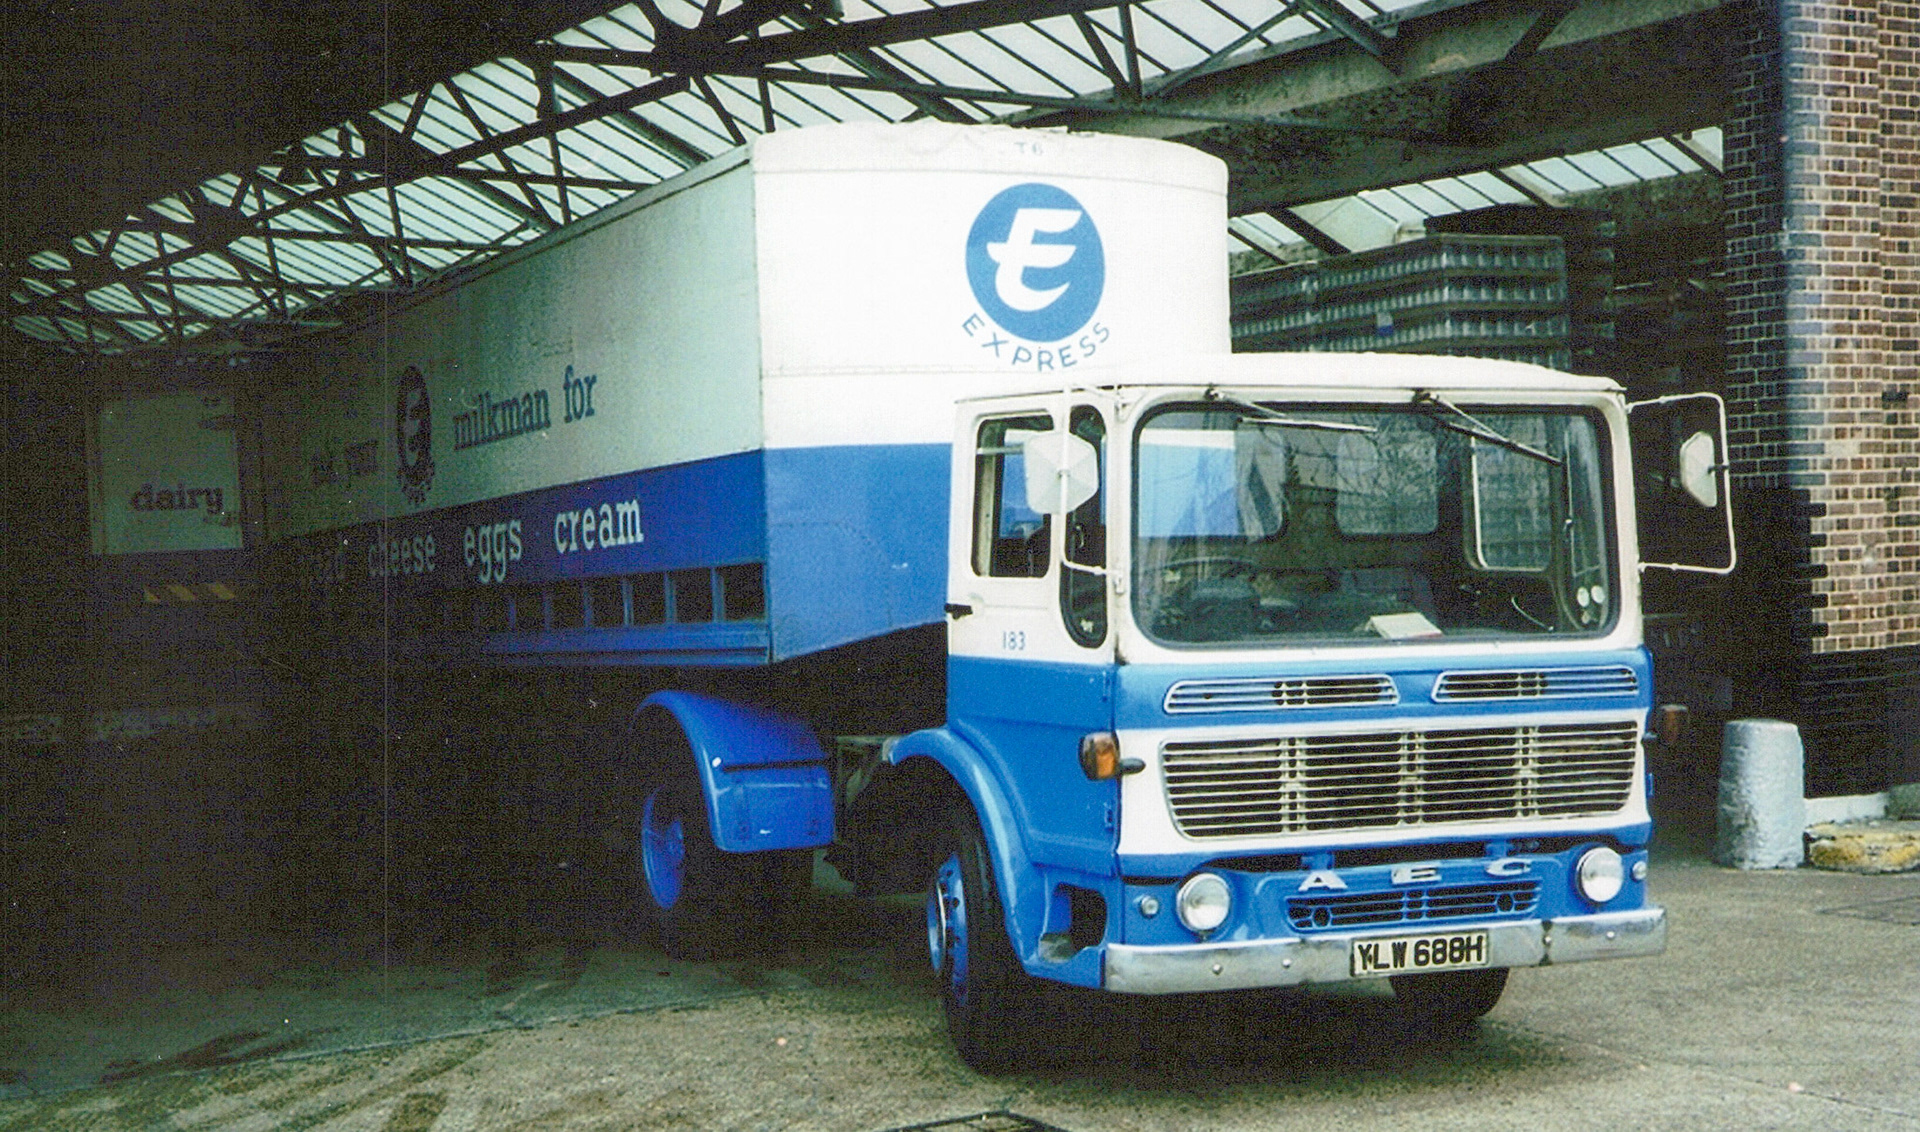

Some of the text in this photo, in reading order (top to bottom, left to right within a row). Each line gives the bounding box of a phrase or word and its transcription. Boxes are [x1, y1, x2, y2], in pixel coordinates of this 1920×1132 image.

[986, 208, 1083, 313] E
[961, 312, 1110, 372] EXPRESS
[453, 364, 597, 451] milkman for
[131, 482, 223, 515] dairy
[367, 526, 436, 577] cheese
[463, 518, 523, 585] eggs
[554, 498, 645, 555] cream
[1003, 630, 1027, 651] 183
[1297, 856, 1534, 893] AEC
[1357, 934, 1485, 971] YLW 688H
